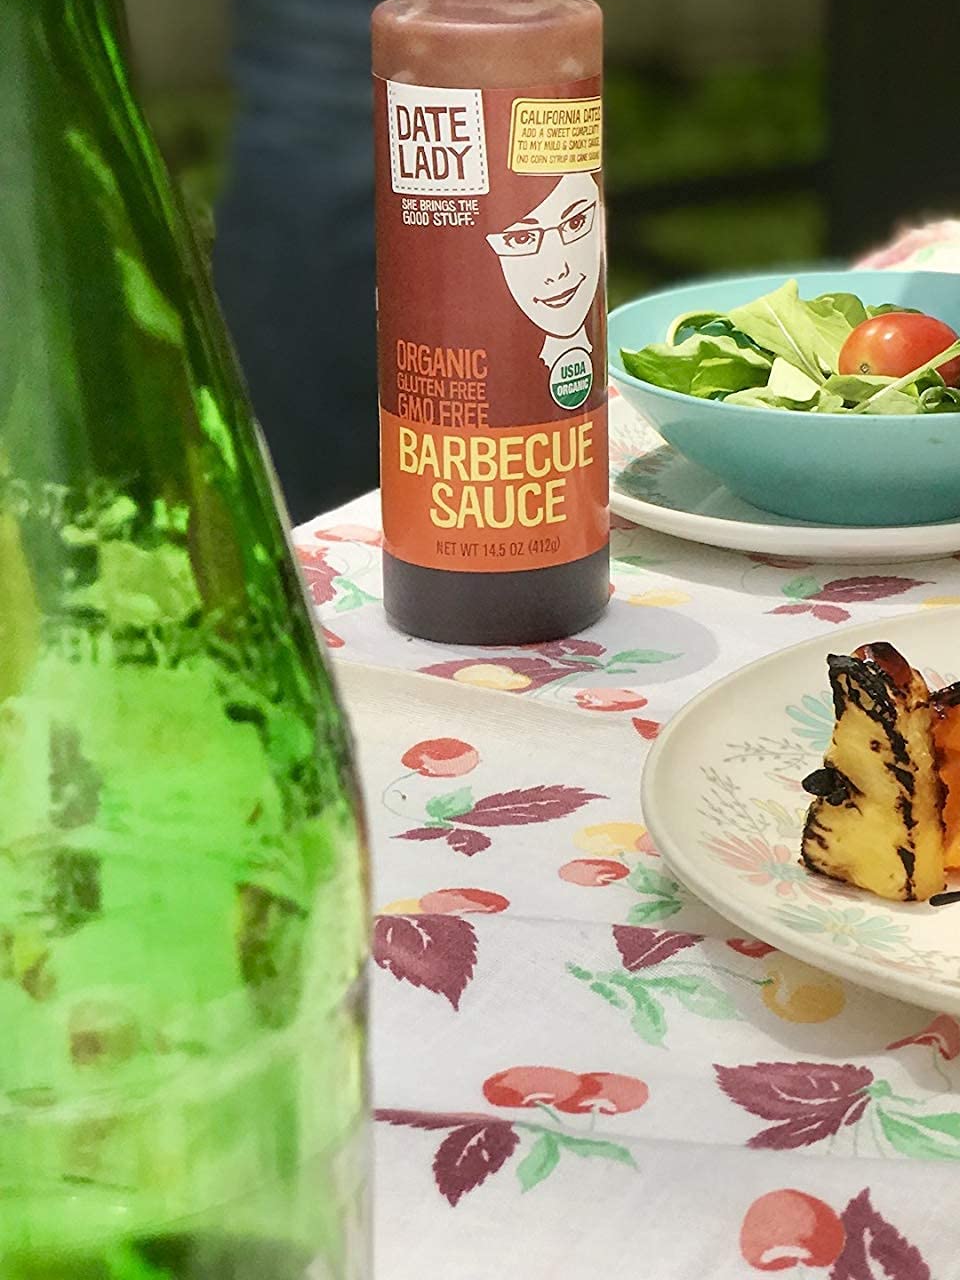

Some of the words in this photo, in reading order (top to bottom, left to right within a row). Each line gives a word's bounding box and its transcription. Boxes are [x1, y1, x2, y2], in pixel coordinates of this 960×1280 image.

[396, 105, 470, 142] DATE
[520, 110, 581, 125] CALIFORNIA
[522, 127, 537, 138] ADD
[546, 127, 571, 138] SWEET
[517, 140, 528, 151] TO
[530, 140, 543, 151] MY
[398, 144, 473, 180] LADY
[402, 198, 418, 211] SHE
[420, 199, 456, 212] BRINGS
[458, 200, 479, 211] THE
[403, 212, 429, 225] GOOD
[396, 339, 488, 380] ORGANIC
[560, 361, 587, 380] USDA
[396, 372, 445, 399] GLUTEN
[450, 381, 486, 401] FREE
[556, 379, 589, 397] ORGANIC
[397, 393, 434, 425] GMO
[439, 400, 489, 428] FREE
[399, 421, 593, 482] BARBECUE
[429, 478, 567, 529] SAUCE
[436, 540, 457, 556] NET
[460, 542, 479, 557] WT
[483, 542, 506, 557] 14.5
[509, 542, 524, 556] OZ
[528, 536, 561, 554] (412g)
